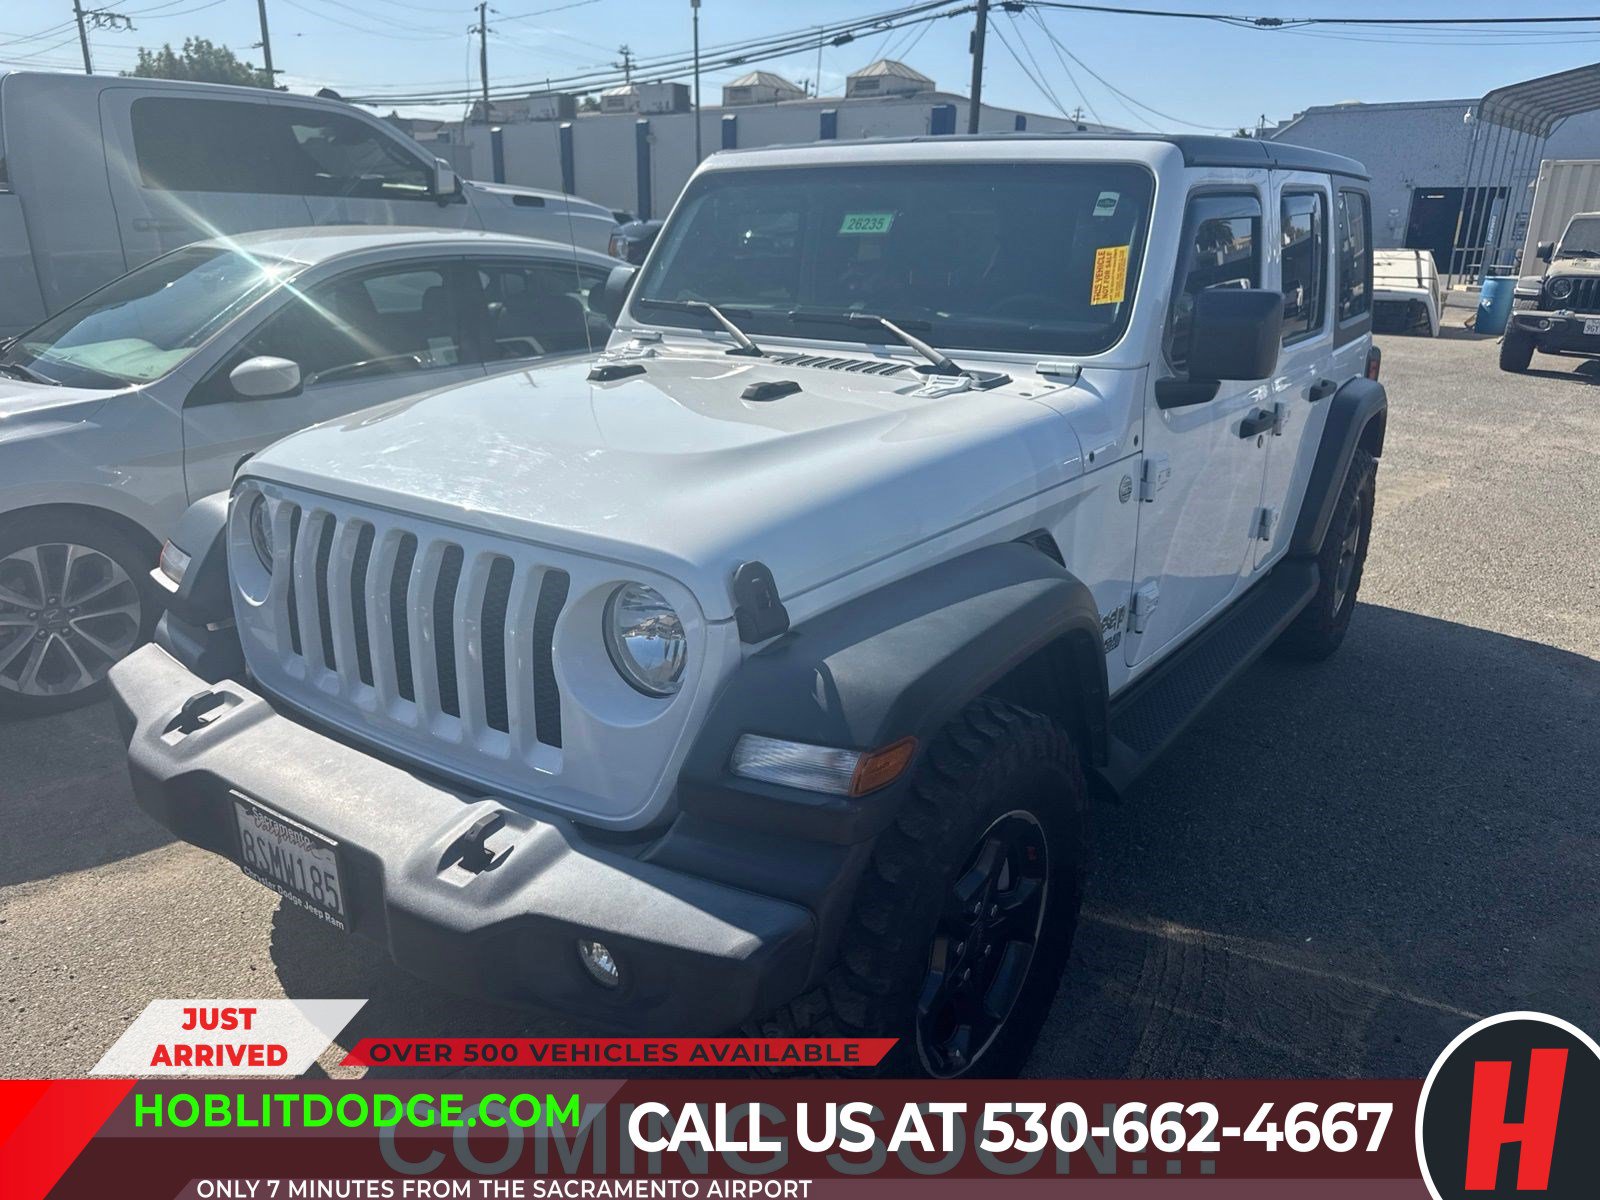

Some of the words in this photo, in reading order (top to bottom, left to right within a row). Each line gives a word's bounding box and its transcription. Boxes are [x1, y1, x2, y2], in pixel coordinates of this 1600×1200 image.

[847, 218, 885, 230] 26235
[252, 807, 313, 847] Sacramento
[243, 829, 340, 912] 8SMW185
[277, 885, 303, 906] Dodge
[303, 901, 324, 919] Jeep
[324, 912, 345, 930] Ram
